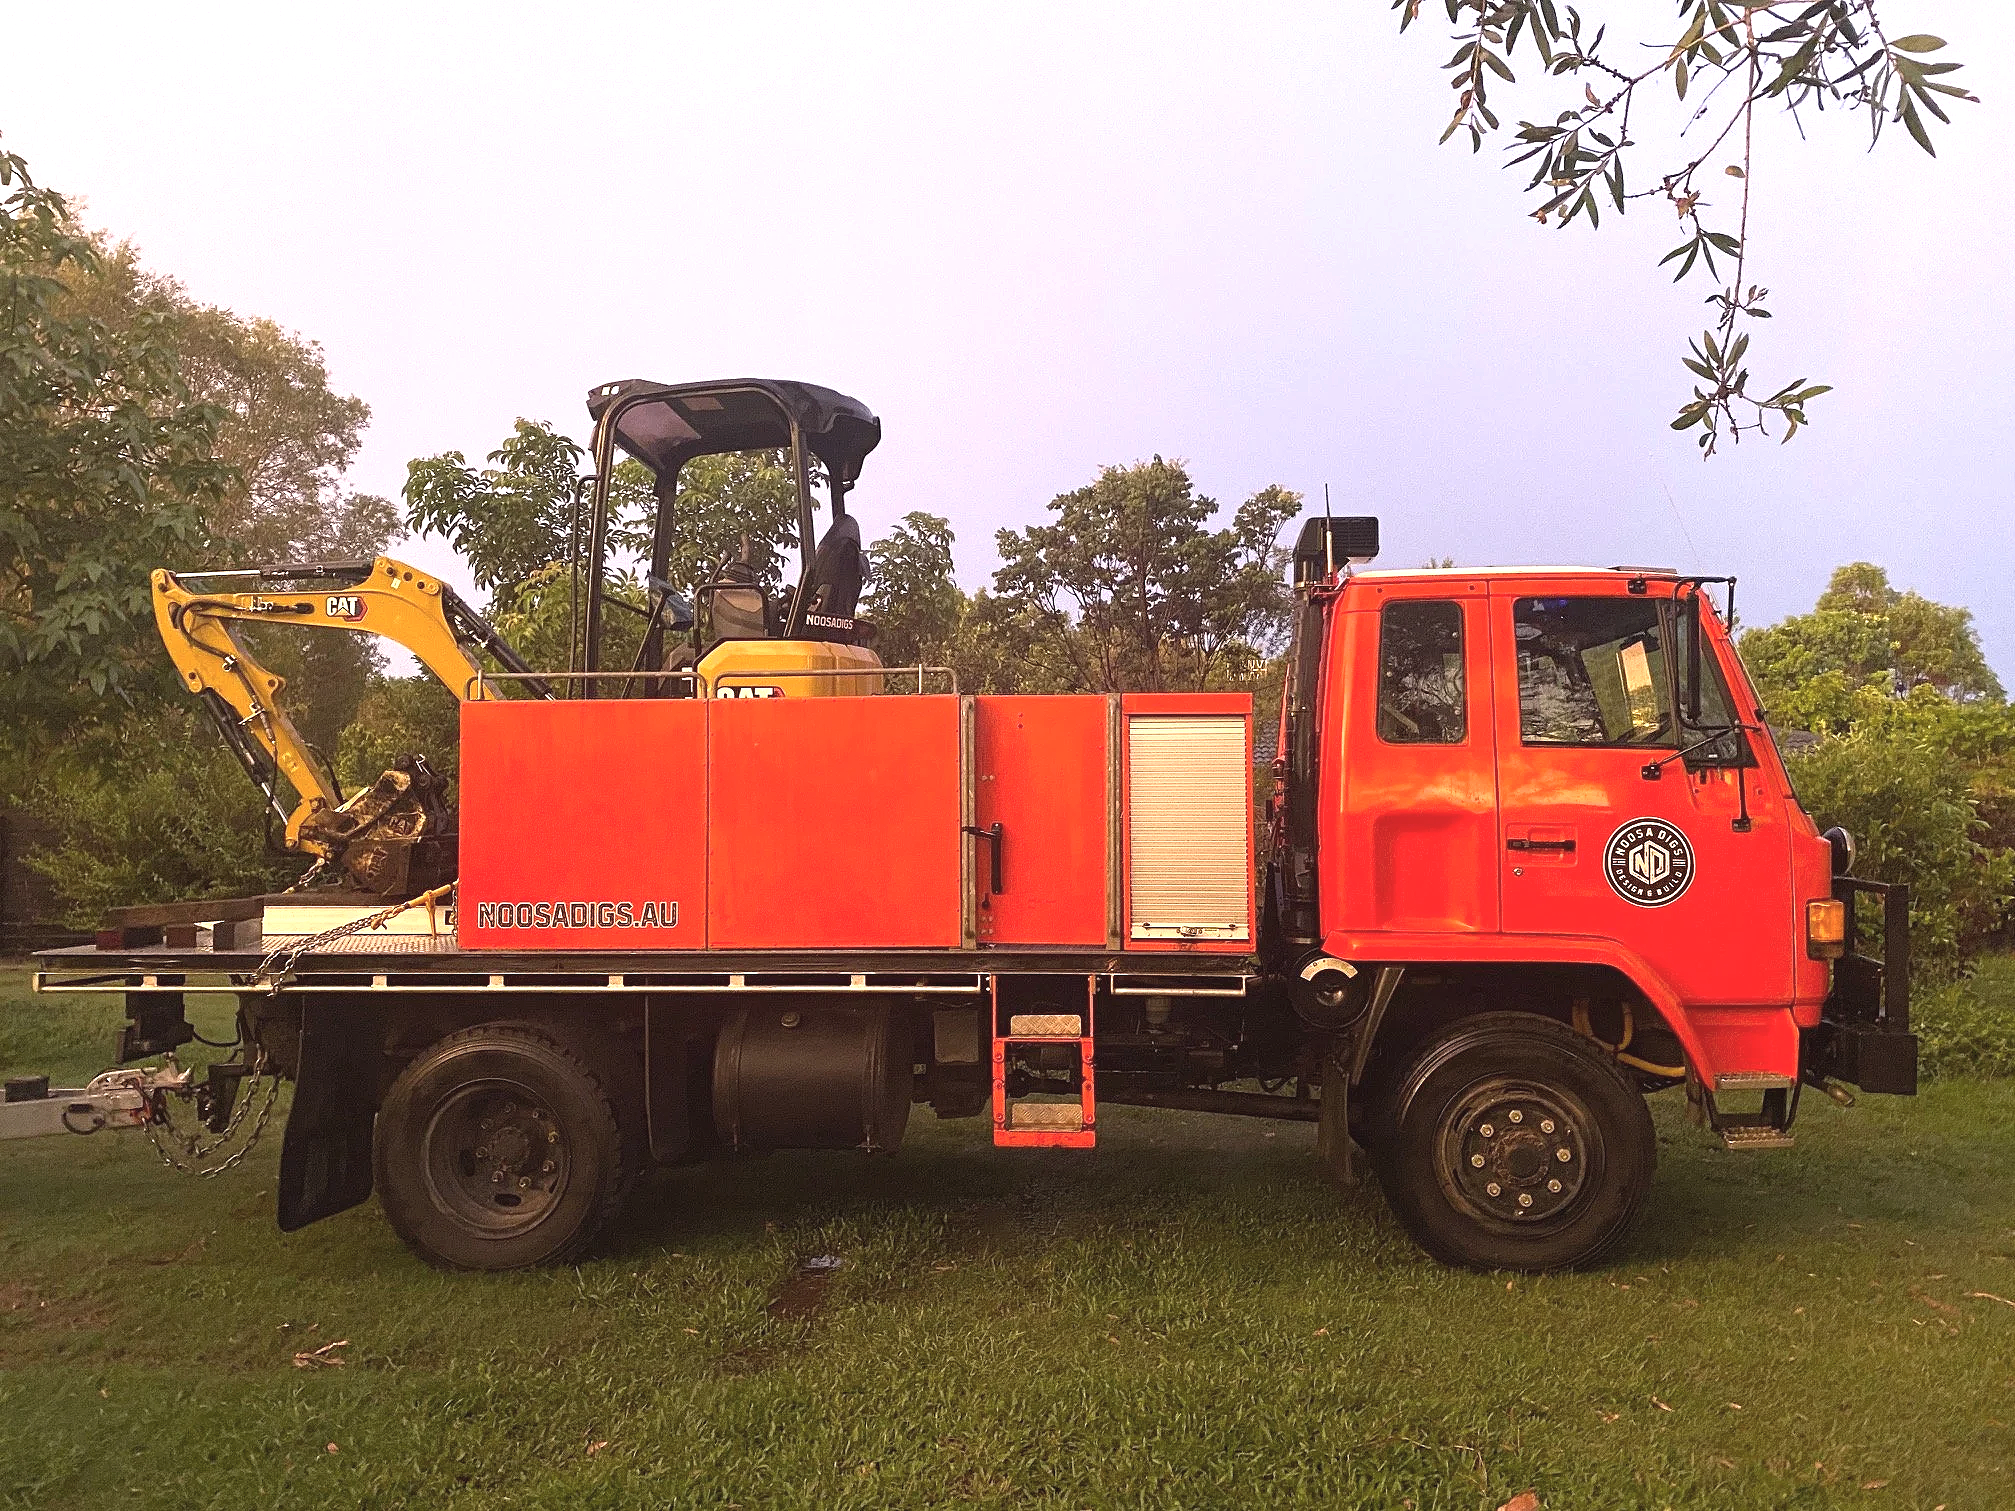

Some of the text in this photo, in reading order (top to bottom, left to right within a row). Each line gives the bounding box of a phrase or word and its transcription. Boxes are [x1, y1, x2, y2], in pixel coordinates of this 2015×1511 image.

[326, 596, 358, 616] CAT
[805, 614, 854, 630] NOOSADIGS
[1615, 827, 1684, 856] NOOSA DIGS
[1615, 868, 1644, 896] DESIGN
[1656, 870, 1683, 896] BUILD
[477, 901, 679, 929] NOOSADIGS.AU
